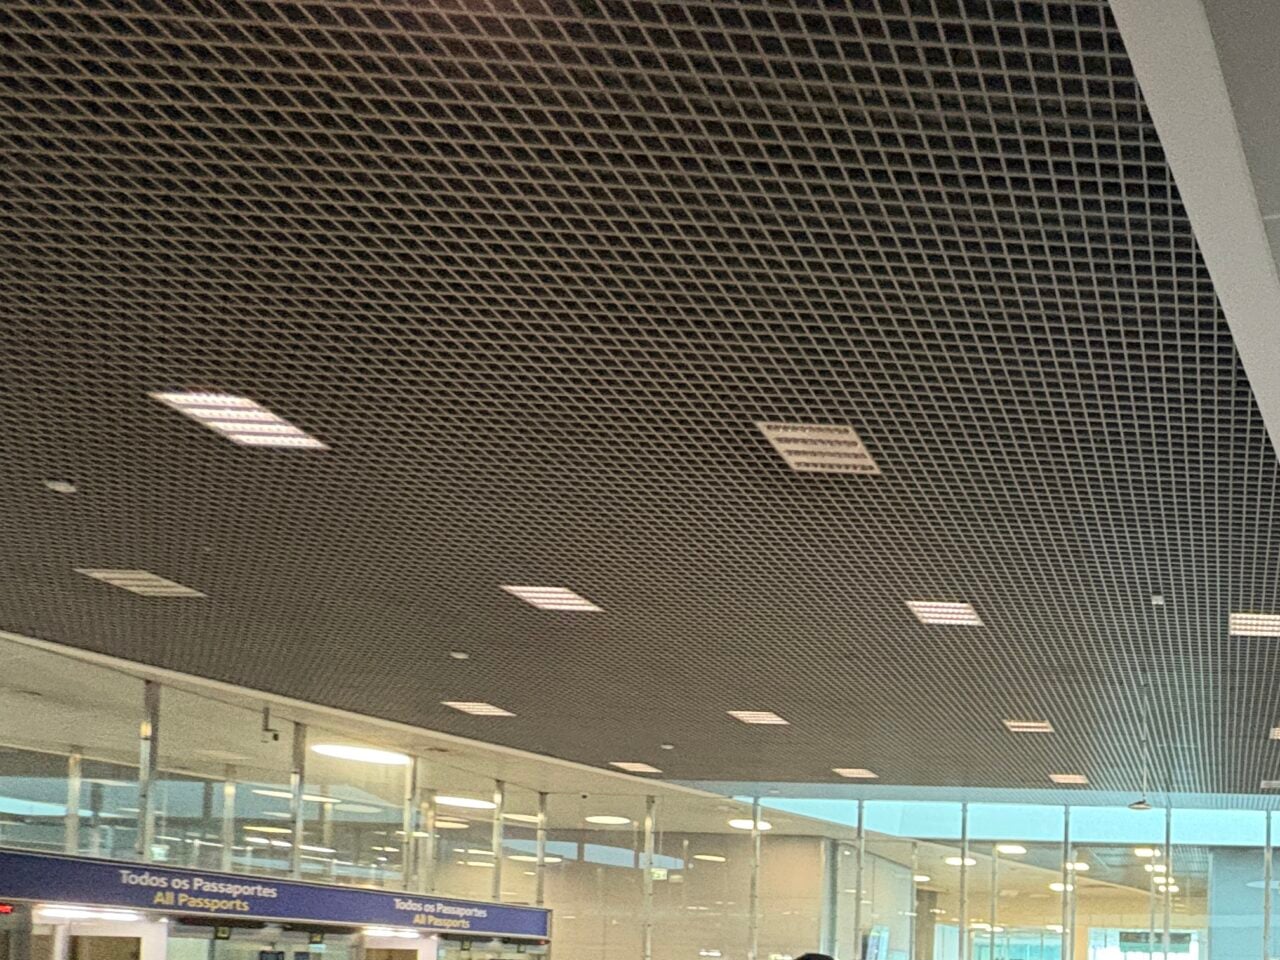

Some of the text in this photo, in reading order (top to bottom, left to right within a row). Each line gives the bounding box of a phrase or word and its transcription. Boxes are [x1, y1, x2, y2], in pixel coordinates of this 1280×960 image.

[119, 870, 277, 898] Todos os Passaportes
[154, 891, 249, 912] All Passports
[393, 898, 488, 918] Todos os Passaportes
[413, 914, 470, 929] All Passports
